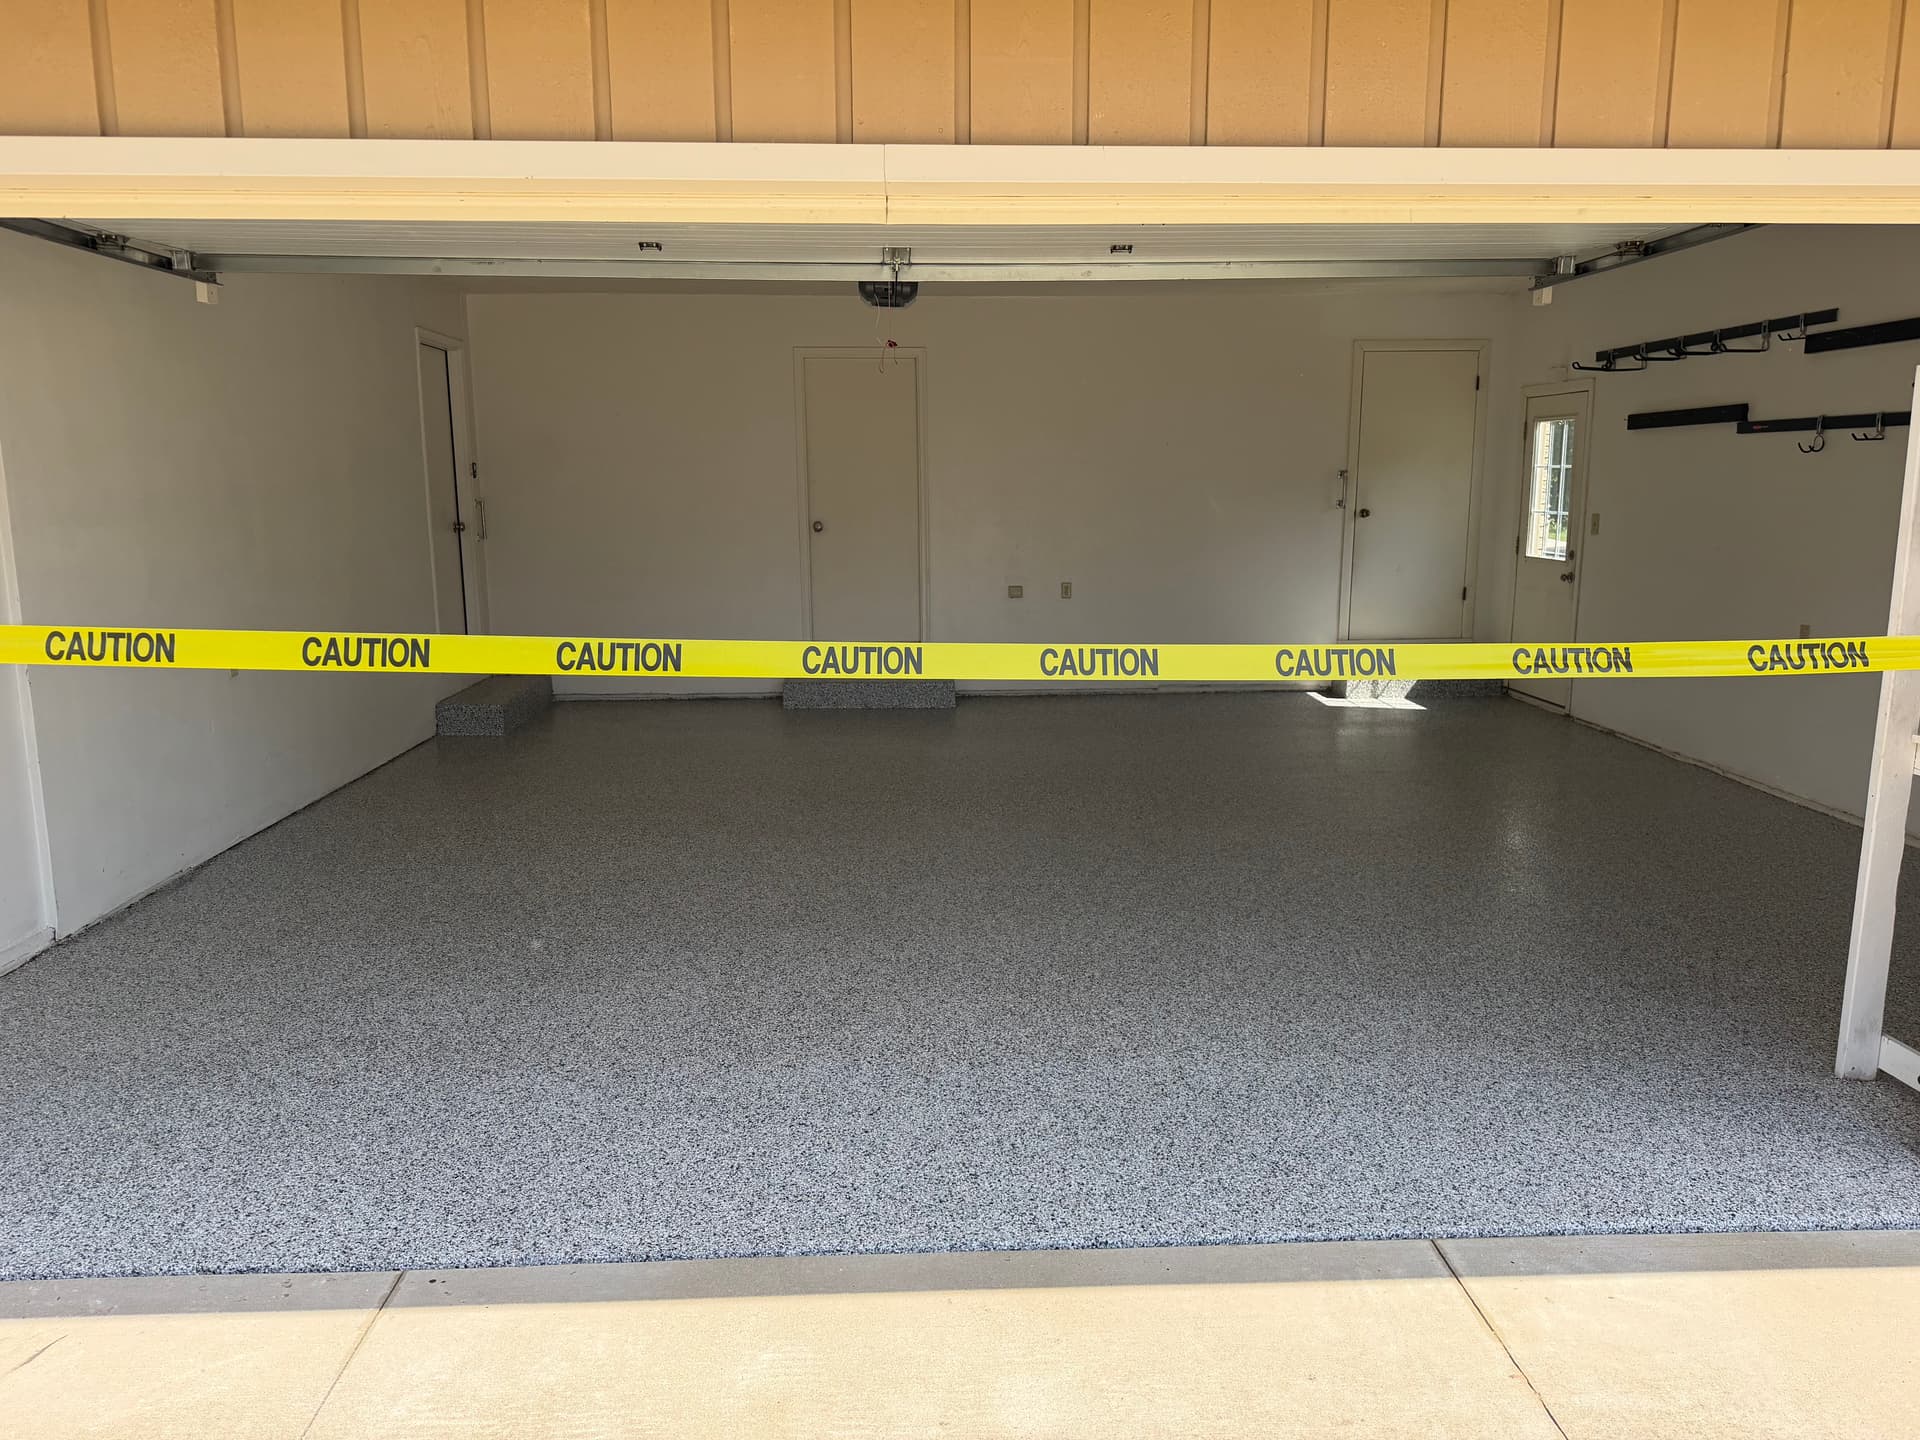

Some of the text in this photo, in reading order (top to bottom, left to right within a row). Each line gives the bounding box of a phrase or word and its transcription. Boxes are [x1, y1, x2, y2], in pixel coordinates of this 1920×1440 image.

[46, 631, 1870, 677] CAUTION CAUTION CAUTION CAUTION CAUTION CAUTION CAUTION CAUTION
